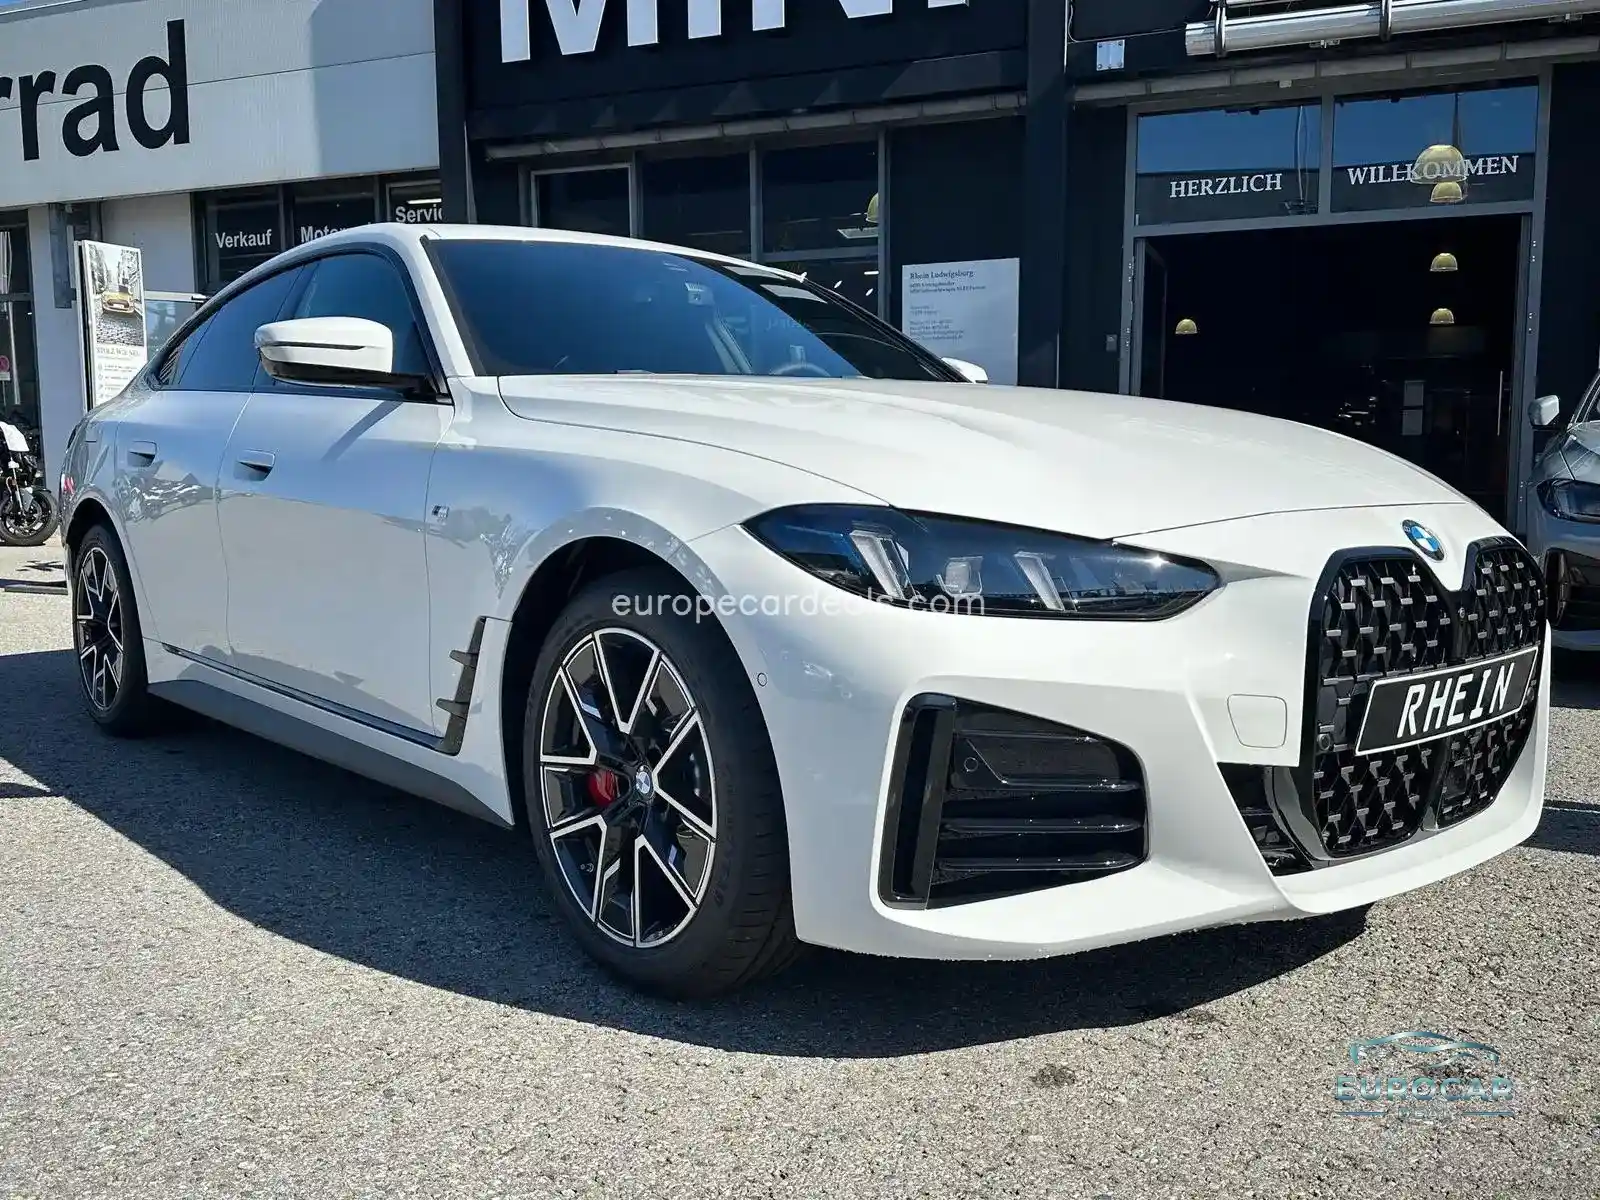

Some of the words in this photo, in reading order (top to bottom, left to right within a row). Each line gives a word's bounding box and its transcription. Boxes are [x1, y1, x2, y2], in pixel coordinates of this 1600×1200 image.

[1347, 155, 1519, 185] WILLKOMMEN
[1170, 173, 1283, 198] HERZLICH
[215, 229, 273, 249] Verkauf
[1397, 662, 1515, 739] RHEIN
